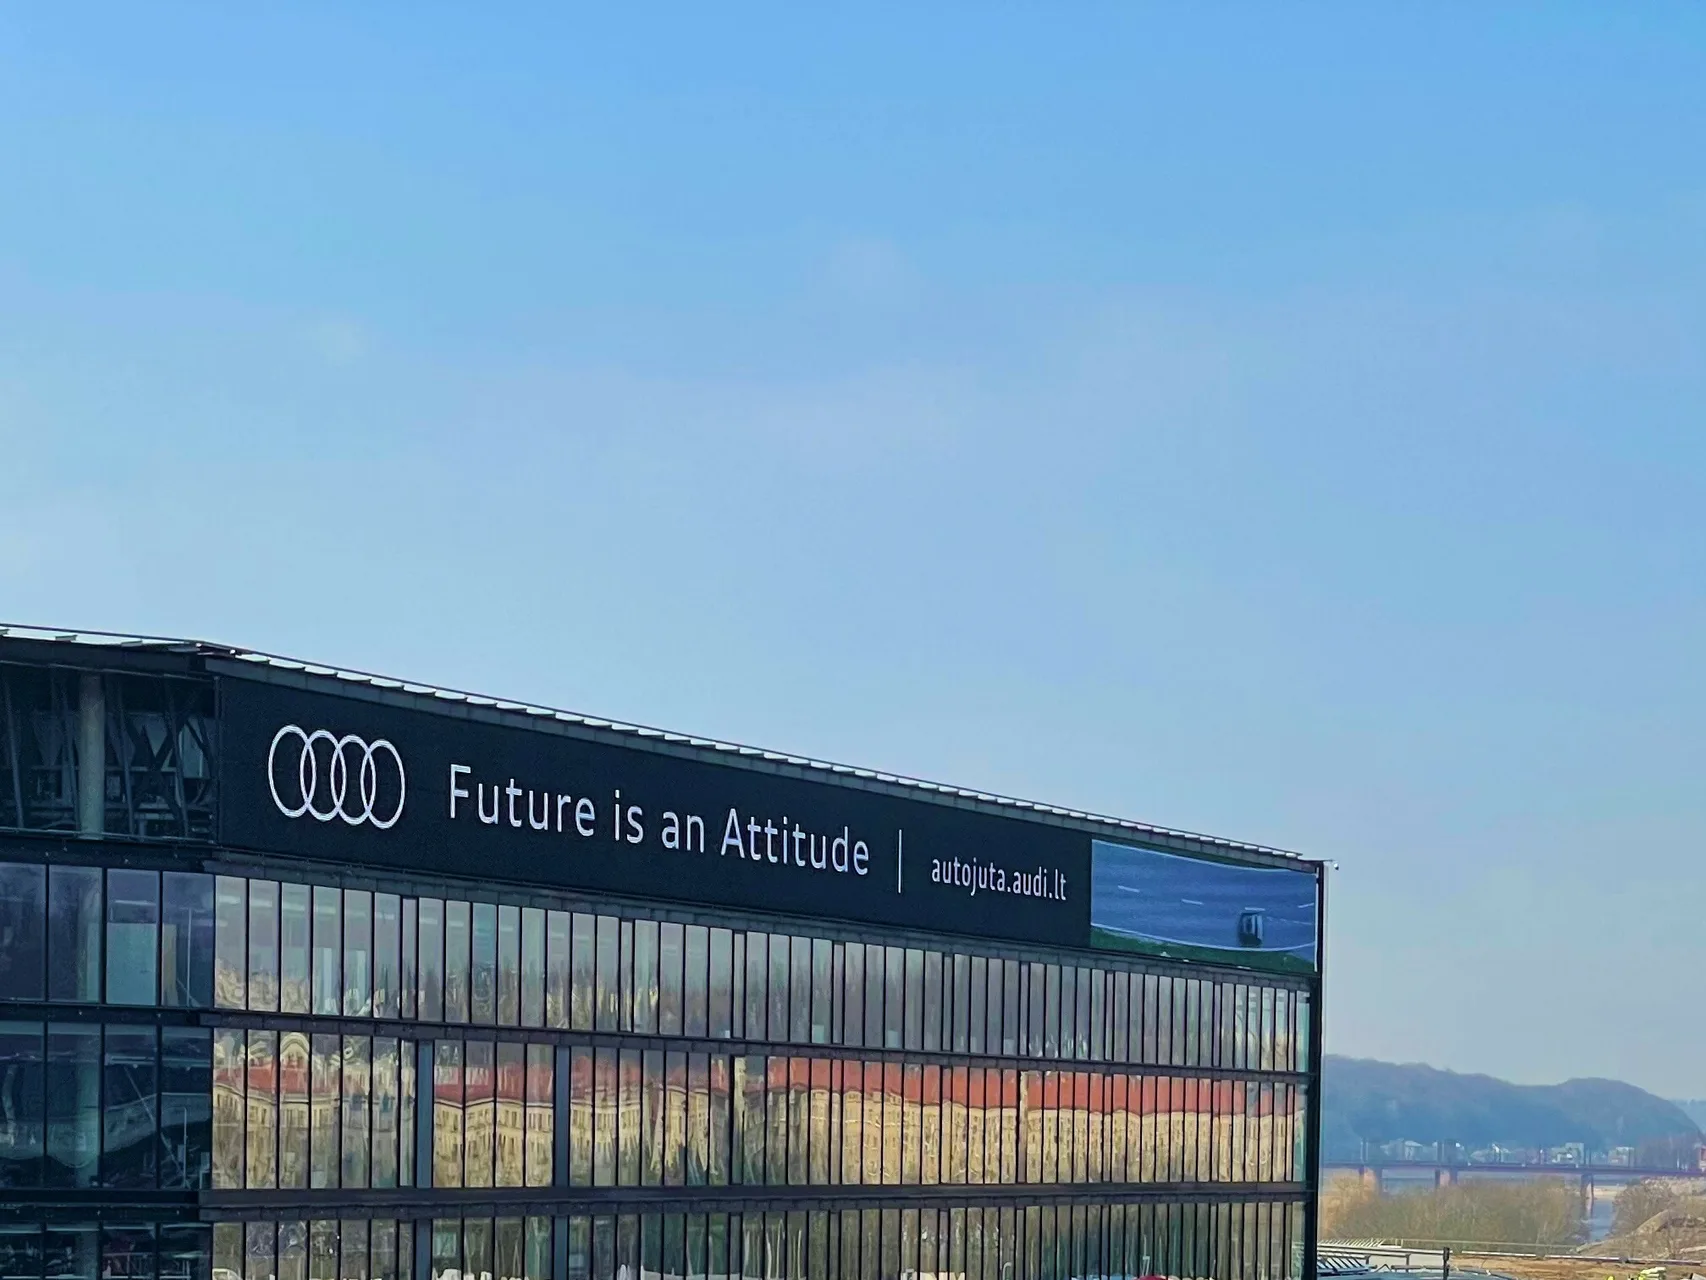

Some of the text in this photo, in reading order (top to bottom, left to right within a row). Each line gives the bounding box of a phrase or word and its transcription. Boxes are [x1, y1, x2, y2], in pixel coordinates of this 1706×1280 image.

[450, 764, 869, 875] Future is an Attitude
[932, 857, 1067, 901] autojuta.audi.lt
